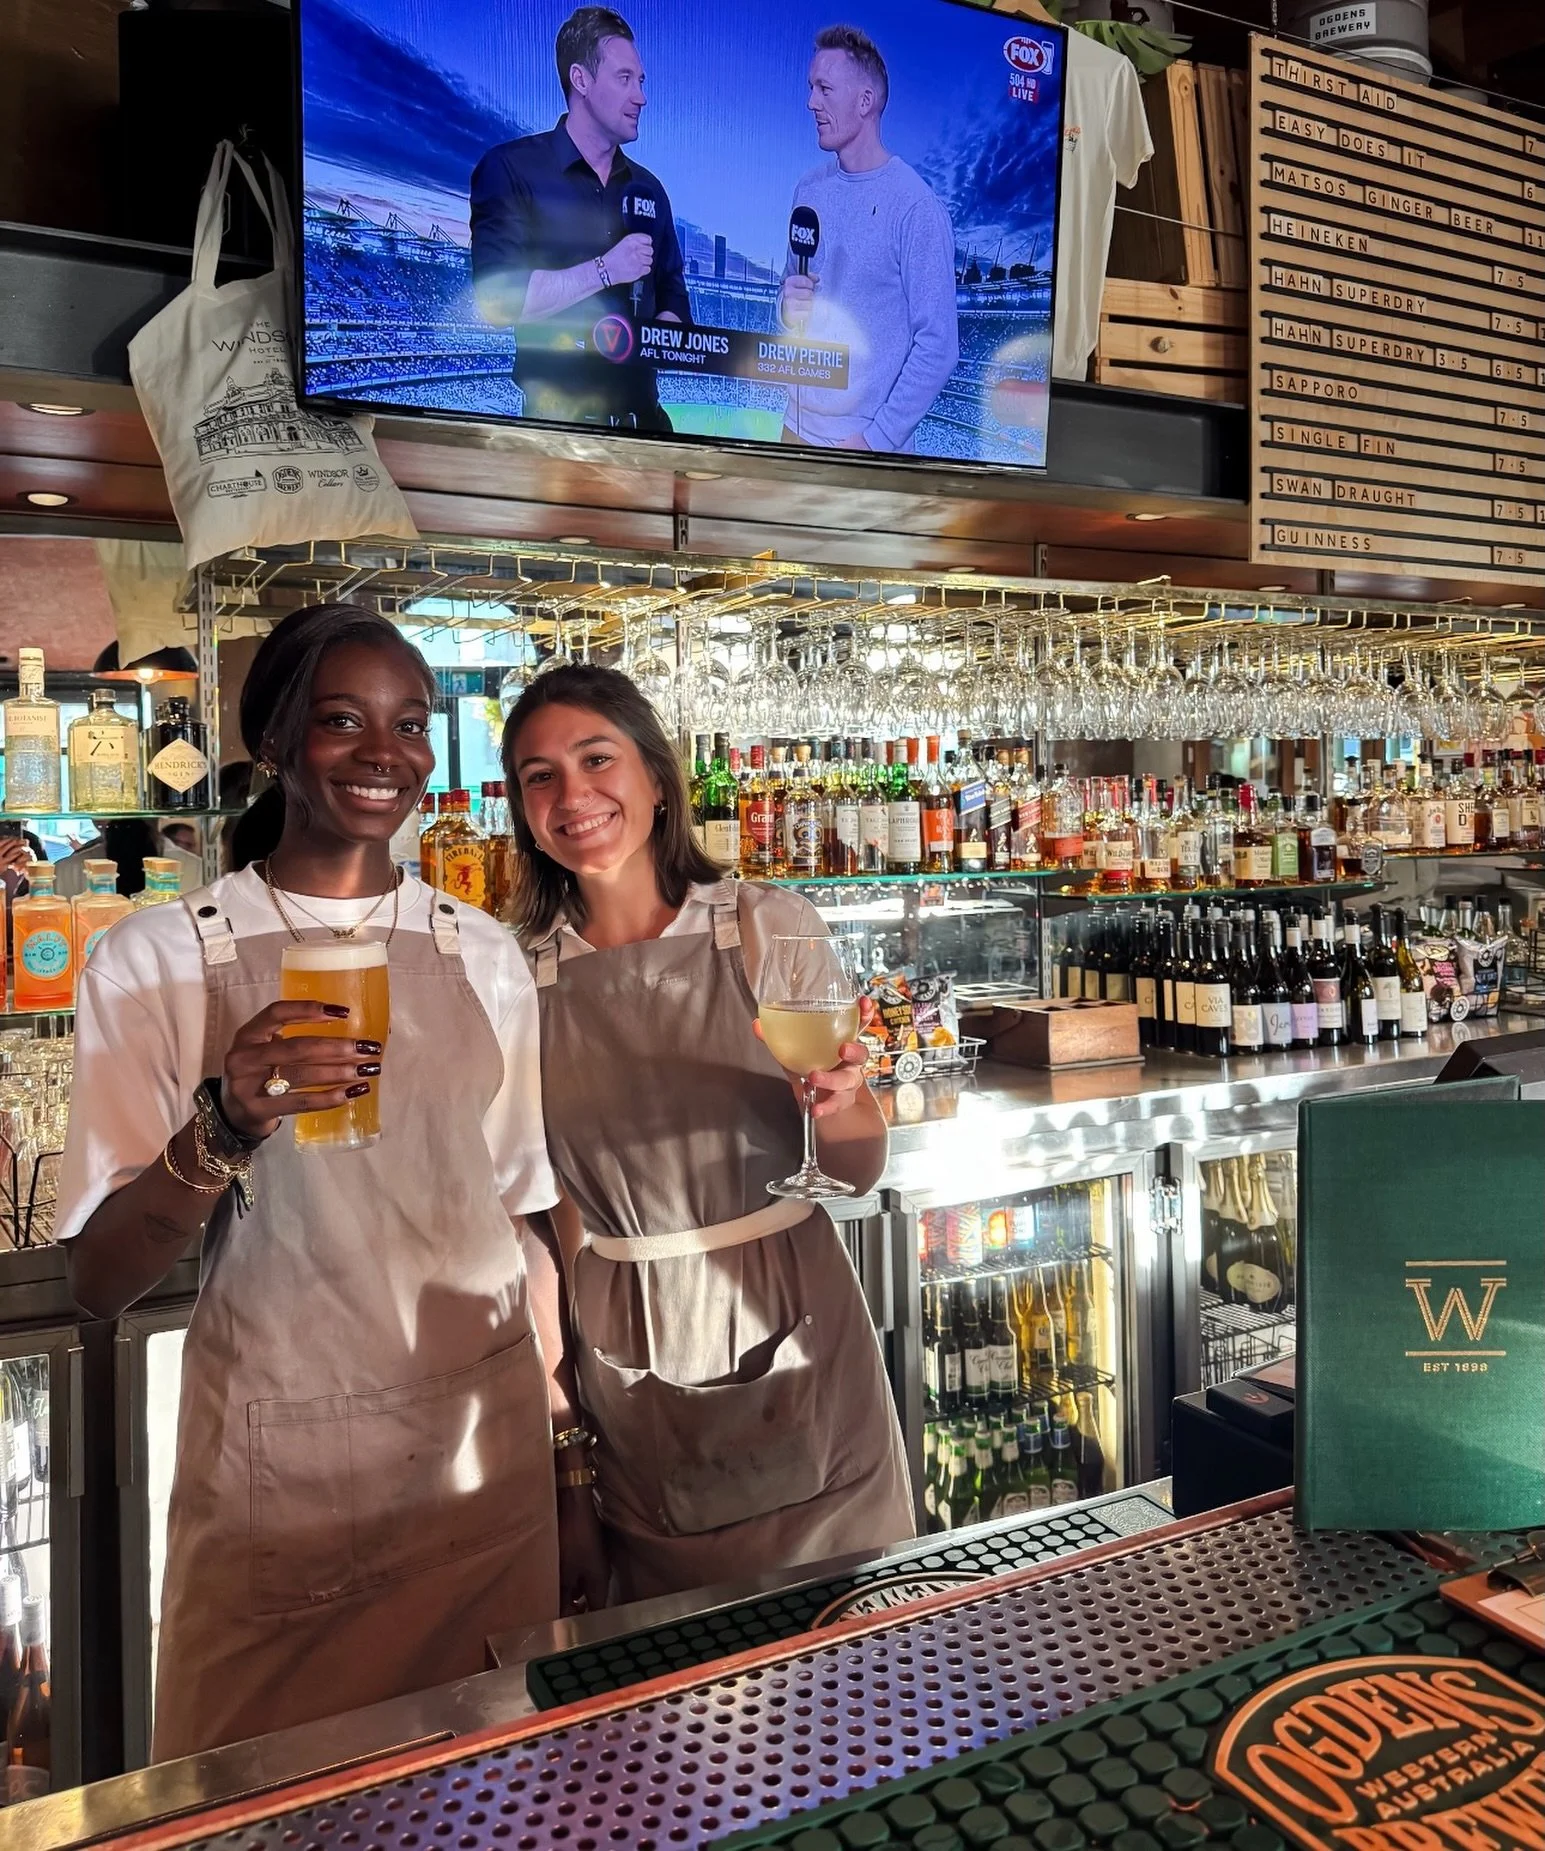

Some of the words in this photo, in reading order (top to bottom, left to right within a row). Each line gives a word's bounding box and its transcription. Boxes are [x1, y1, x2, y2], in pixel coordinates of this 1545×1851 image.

[1319, 9, 1366, 27] OGDENS
[1315, 21, 1371, 41] BREWERY
[1010, 42, 1040, 67] FOX
[1010, 73, 1025, 88] 504
[1276, 62, 1347, 96] THIRST
[1362, 89, 1395, 110] AID
[1012, 86, 1034, 102] LIVE
[1279, 116, 1325, 138] EASY
[1342, 134, 1385, 157] DOES
[1408, 151, 1425, 168] IT
[634, 197, 656, 214] FOX
[1274, 166, 1346, 196] MATSOS
[1368, 191, 1432, 219] GINGER
[1454, 214, 1493, 234] BEER
[791, 224, 815, 241] FOX
[1273, 219, 1368, 252] HEINEKEN
[1274, 271, 1321, 293] HAHN
[1336, 284, 1425, 313] SUPERDRY
[641, 326, 683, 349] DREW
[685, 332, 729, 353] JONES
[1274, 323, 1321, 344] HAHN
[1336, 334, 1424, 362] SUPERDRY
[640, 348, 660, 359] AFL
[661, 350, 706, 364] TONIGHT
[758, 342, 798, 362] DREW
[800, 348, 843, 367] PETRIE
[757, 362, 776, 373] 332
[778, 364, 796, 376] AFL
[798, 367, 831, 379] GAMES
[1276, 375, 1358, 399] SAPPORO
[1277, 427, 1346, 449] SINGLE
[1363, 440, 1395, 455] FIN
[307, 469, 349, 478] WINDSOR
[1277, 479, 1322, 497] SWAN
[1337, 484, 1415, 507] DRAUGHT
[1277, 529, 1371, 550] GUINNESS
[1200, 1004, 1228, 1014] CAVES
[1208, 996, 1224, 1004] VIA
[1405, 1278, 1507, 1341] W
[1423, 1363, 1450, 1372] EST
[1246, 1671, 1545, 1824] OGDENS
[1356, 1731, 1497, 1798] WESTERN
[1375, 1740, 1535, 1820] AUSTRALIA
